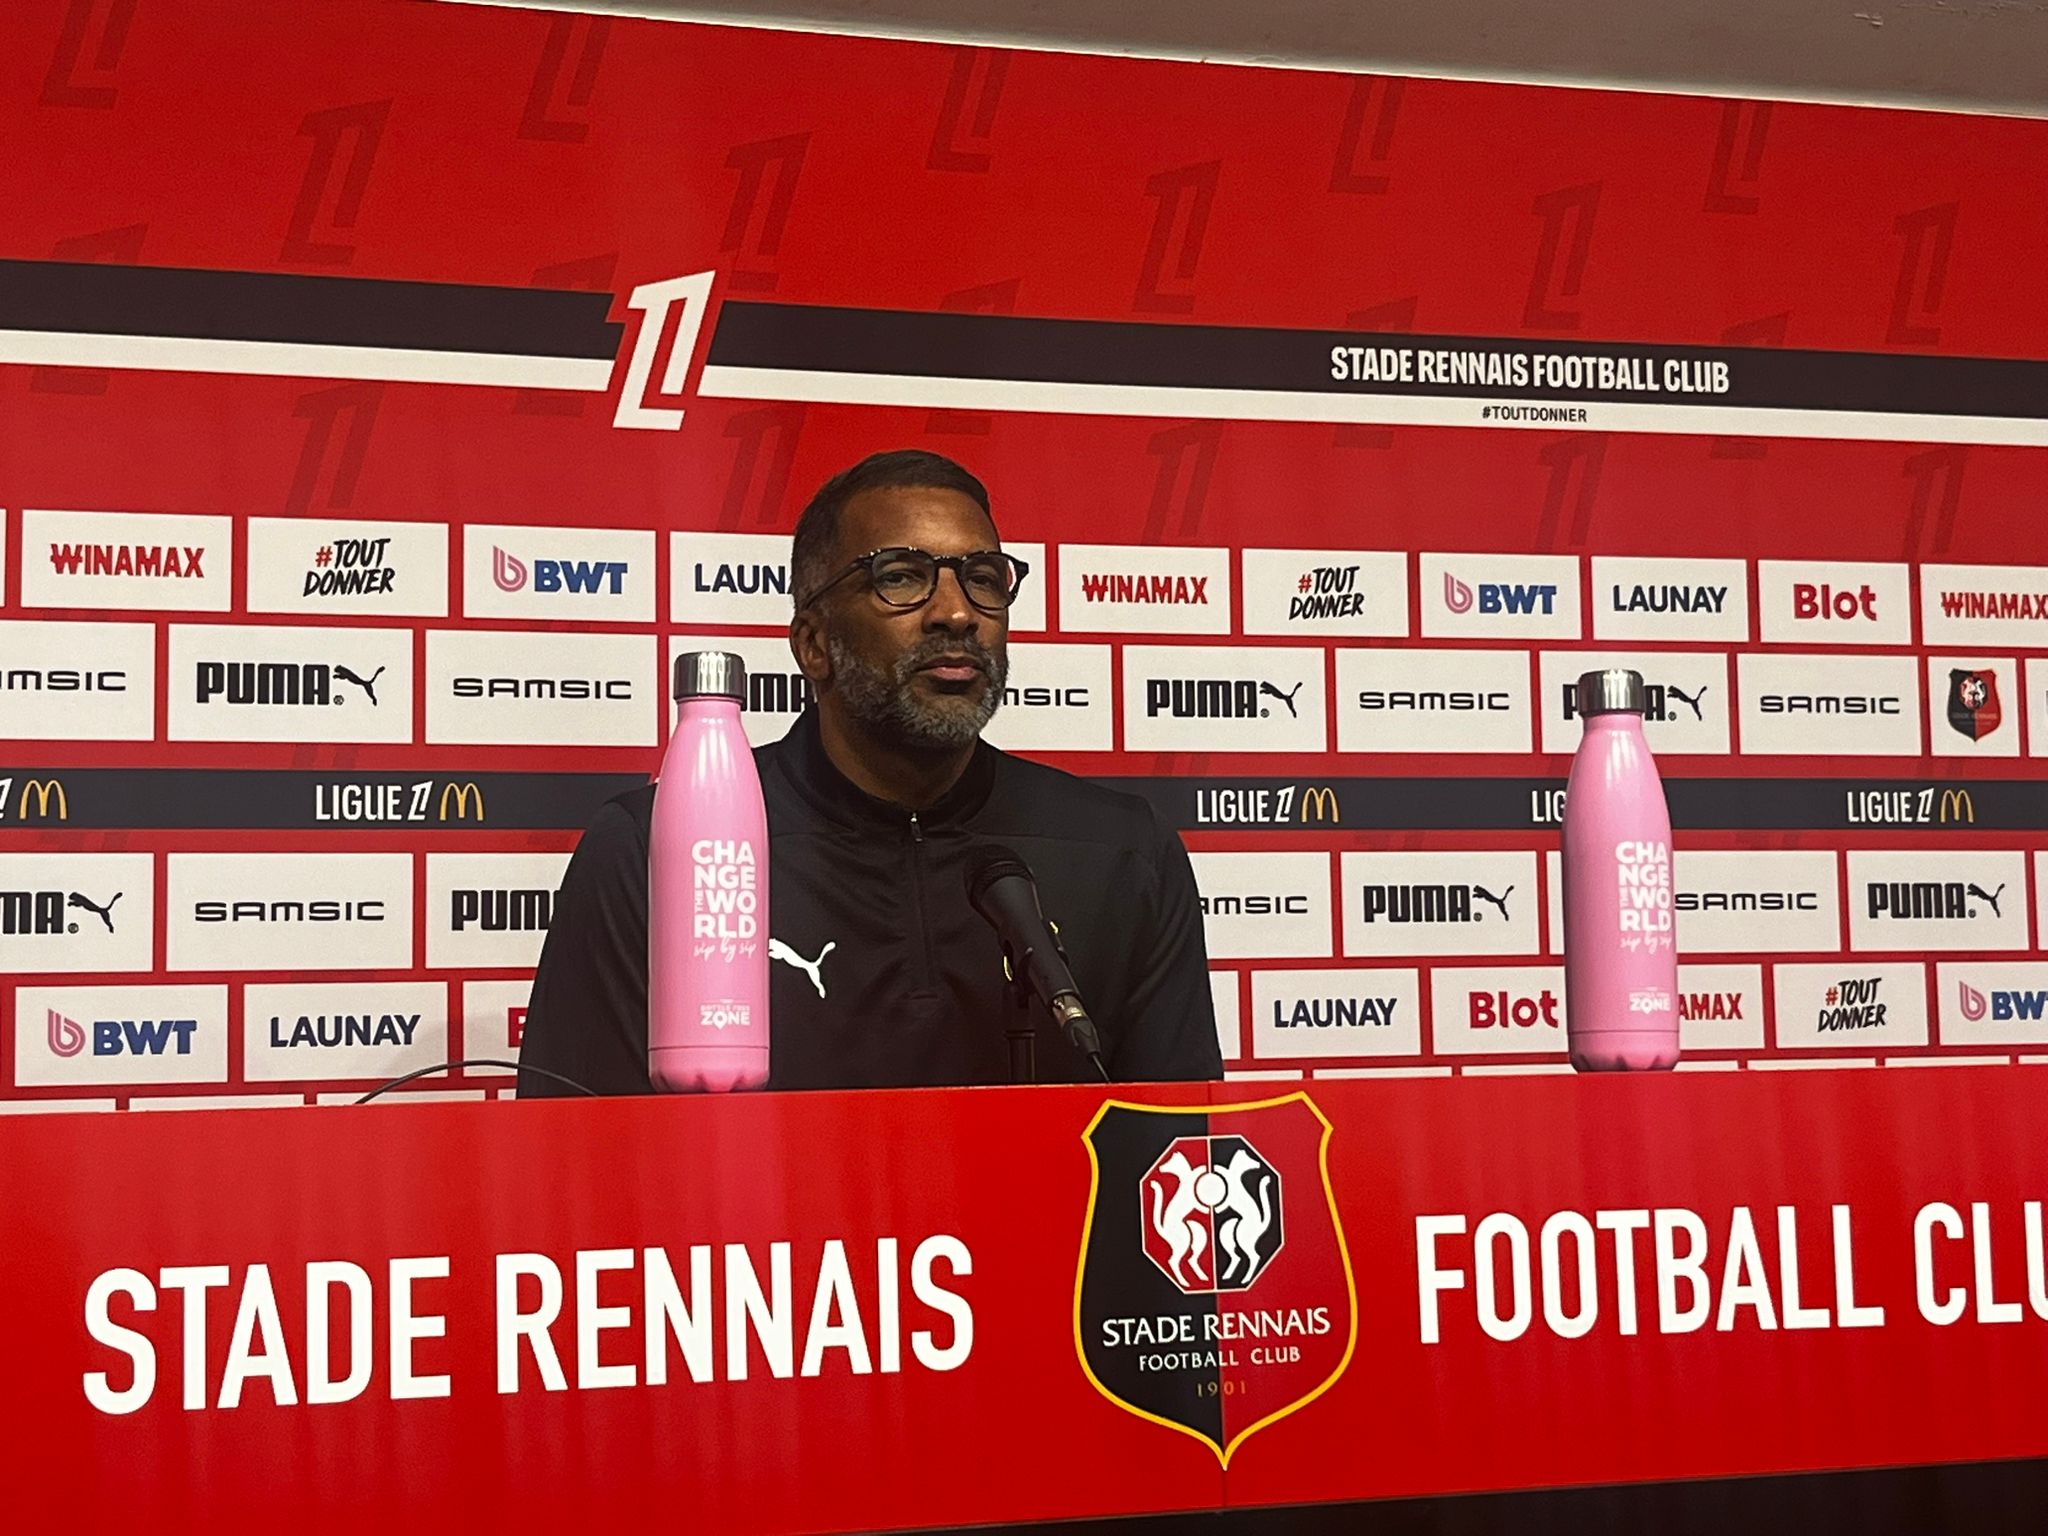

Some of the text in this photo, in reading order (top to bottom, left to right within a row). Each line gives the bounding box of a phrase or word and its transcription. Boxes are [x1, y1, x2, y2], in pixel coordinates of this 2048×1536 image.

[1332, 347, 1729, 393] STADE RENNAIS FOOTBALL CLUB
[1483, 406, 1586, 422] #TOUTDONNER
[50, 544, 204, 578] WINAMAX
[316, 538, 391, 568] #TOUT
[303, 567, 395, 597] DONNER
[535, 560, 627, 594] BWT
[695, 563, 793, 594] LAUN
[1082, 574, 1208, 604] WINAMAX
[1299, 566, 1360, 594] #TOUT
[1289, 592, 1364, 620] DONNER
[1479, 584, 1557, 614] BWT
[1613, 585, 1727, 613] LAUNAY
[1794, 584, 1877, 621] Blot
[1941, 592, 2048, 619] WINAMAX
[0, 670, 126, 691] MSIC
[197, 662, 329, 705] PUMA
[454, 678, 631, 699] SAMSIC
[741, 673, 815, 712] MA
[1003, 687, 1089, 706] MSIC
[1147, 680, 1257, 718] PUMA
[1360, 692, 1509, 710] SAMSIC
[1563, 684, 1665, 721] PA
[1760, 696, 1899, 714] SAMSIC
[316, 785, 402, 820] LIGUE
[1197, 790, 1270, 822] LIGUE
[1531, 790, 1567, 822] LIG
[1847, 791, 1912, 823] LIGUE
[692, 840, 756, 865] CHA
[1615, 841, 1669, 865] CHA
[694, 864, 756, 890] NGE
[1618, 864, 1669, 887] NGE
[195, 902, 384, 921] SAMSIC
[452, 890, 561, 931] PUM
[705, 889, 757, 914] WO
[1200, 896, 1308, 915] MSIC
[1363, 885, 1470, 922] PUMA
[1629, 886, 1671, 909] WO
[1675, 892, 1818, 911] SAMSIC
[1868, 883, 1966, 919] PUMA
[0, 891, 64, 934] MA
[694, 914, 757, 938] RLD
[1619, 908, 1672, 931] RLD
[1679, 992, 1743, 1021] AMAX
[1826, 978, 1882, 1006] #TOUT
[1991, 990, 2048, 1021] BW
[700, 1010, 750, 1030] ZONE
[1275, 998, 1397, 1027] LAUNAY
[1469, 990, 1558, 1028] Blot
[1817, 1004, 1886, 1033] DONNER
[94, 1020, 197, 1055] BWT
[271, 1015, 420, 1047] LAUNAY
[1416, 1205, 1884, 1343] FOOTBALL
[84, 1235, 973, 1414] STADE RENNAIS
[1102, 1307, 1331, 1347] STADE RENNAIS
[1139, 1346, 1301, 1371] FOOTBALL CLUB
[1196, 1380, 1248, 1398] 1901
